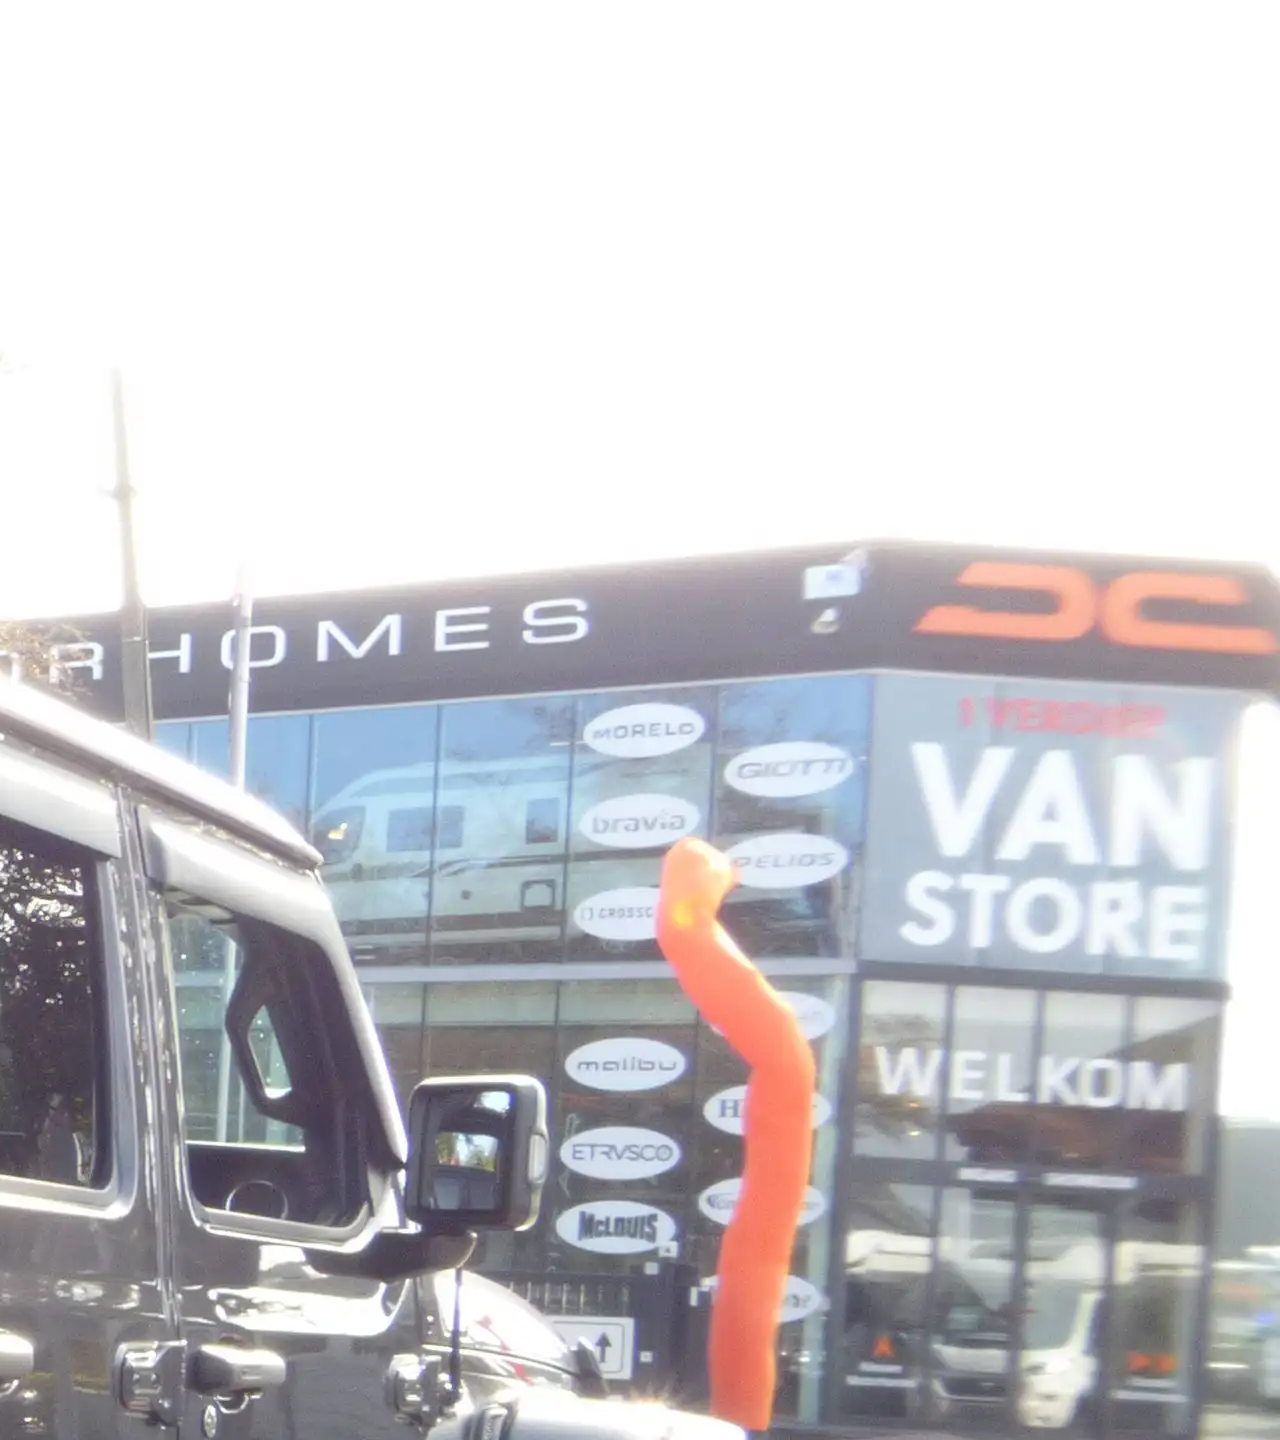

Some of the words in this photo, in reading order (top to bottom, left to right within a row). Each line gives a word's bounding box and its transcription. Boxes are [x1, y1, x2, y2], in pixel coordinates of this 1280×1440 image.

[591, 722, 696, 741] MORELO
[910, 742, 1216, 871] VAN
[592, 809, 685, 835] bravia
[597, 905, 653, 919] CROSSC
[899, 870, 1209, 960] STORE
[577, 1056, 677, 1072] malibu
[872, 1045, 1189, 1112] WELKOM
